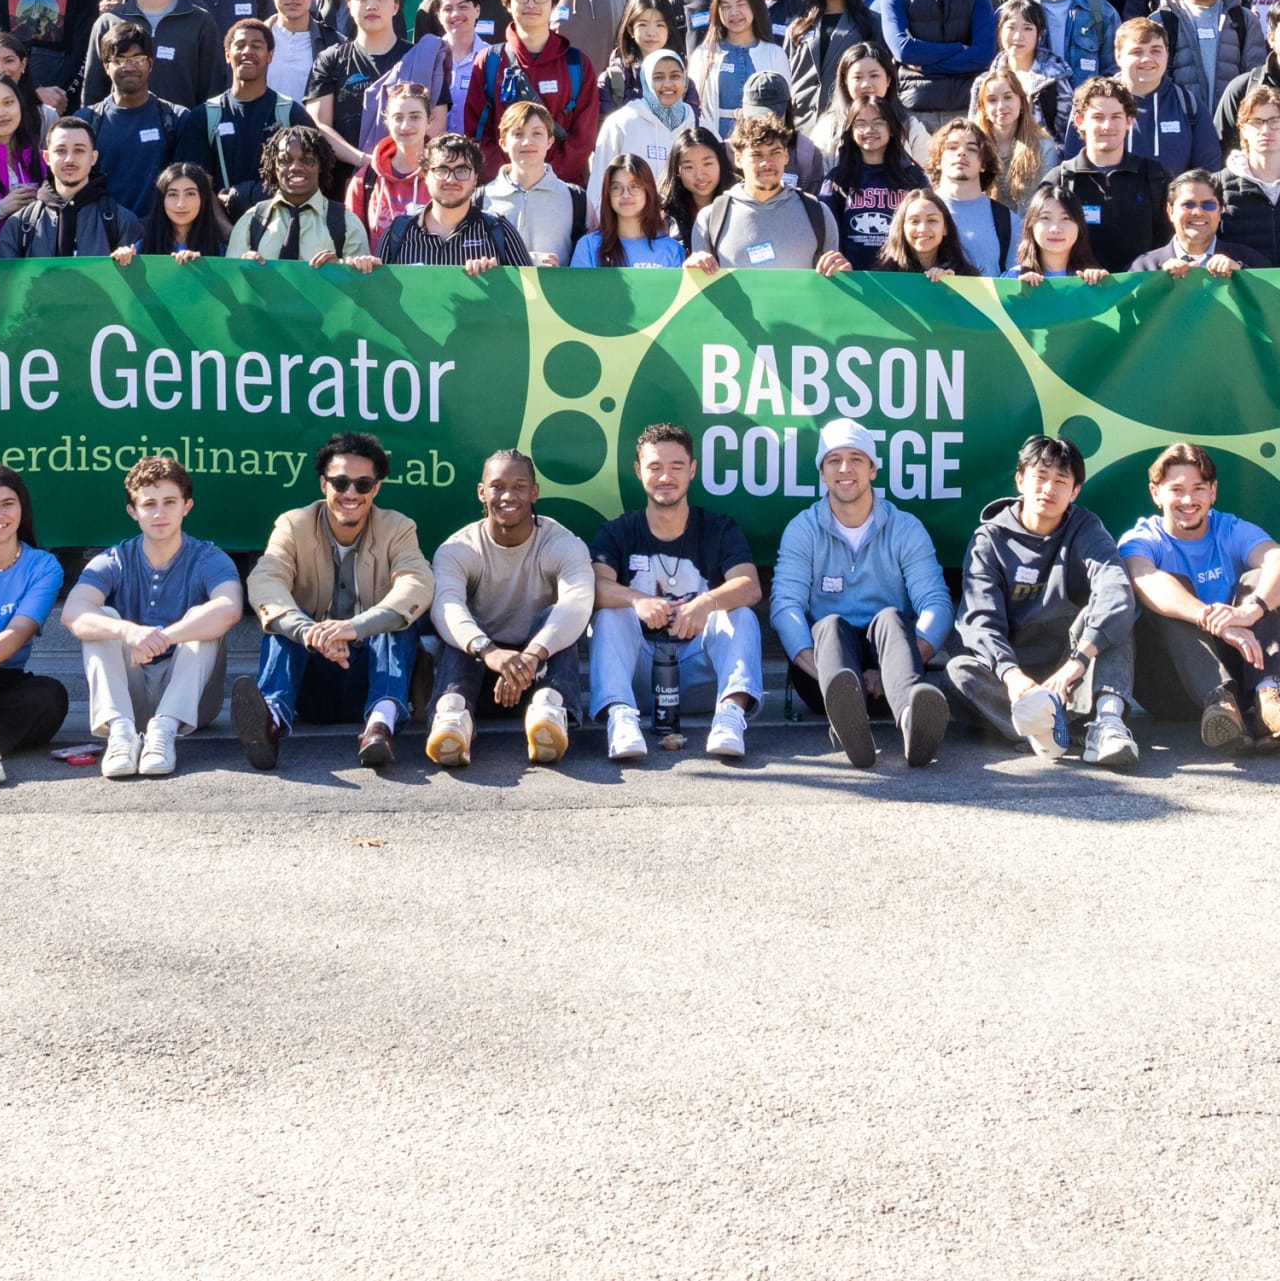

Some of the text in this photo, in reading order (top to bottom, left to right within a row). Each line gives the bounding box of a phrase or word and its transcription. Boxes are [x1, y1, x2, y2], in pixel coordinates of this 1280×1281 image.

[90, 324, 457, 423] Generator
[702, 343, 965, 420] BABSON
[701, 424, 964, 500] COLGE
[1198, 567, 1222, 583] STAF
